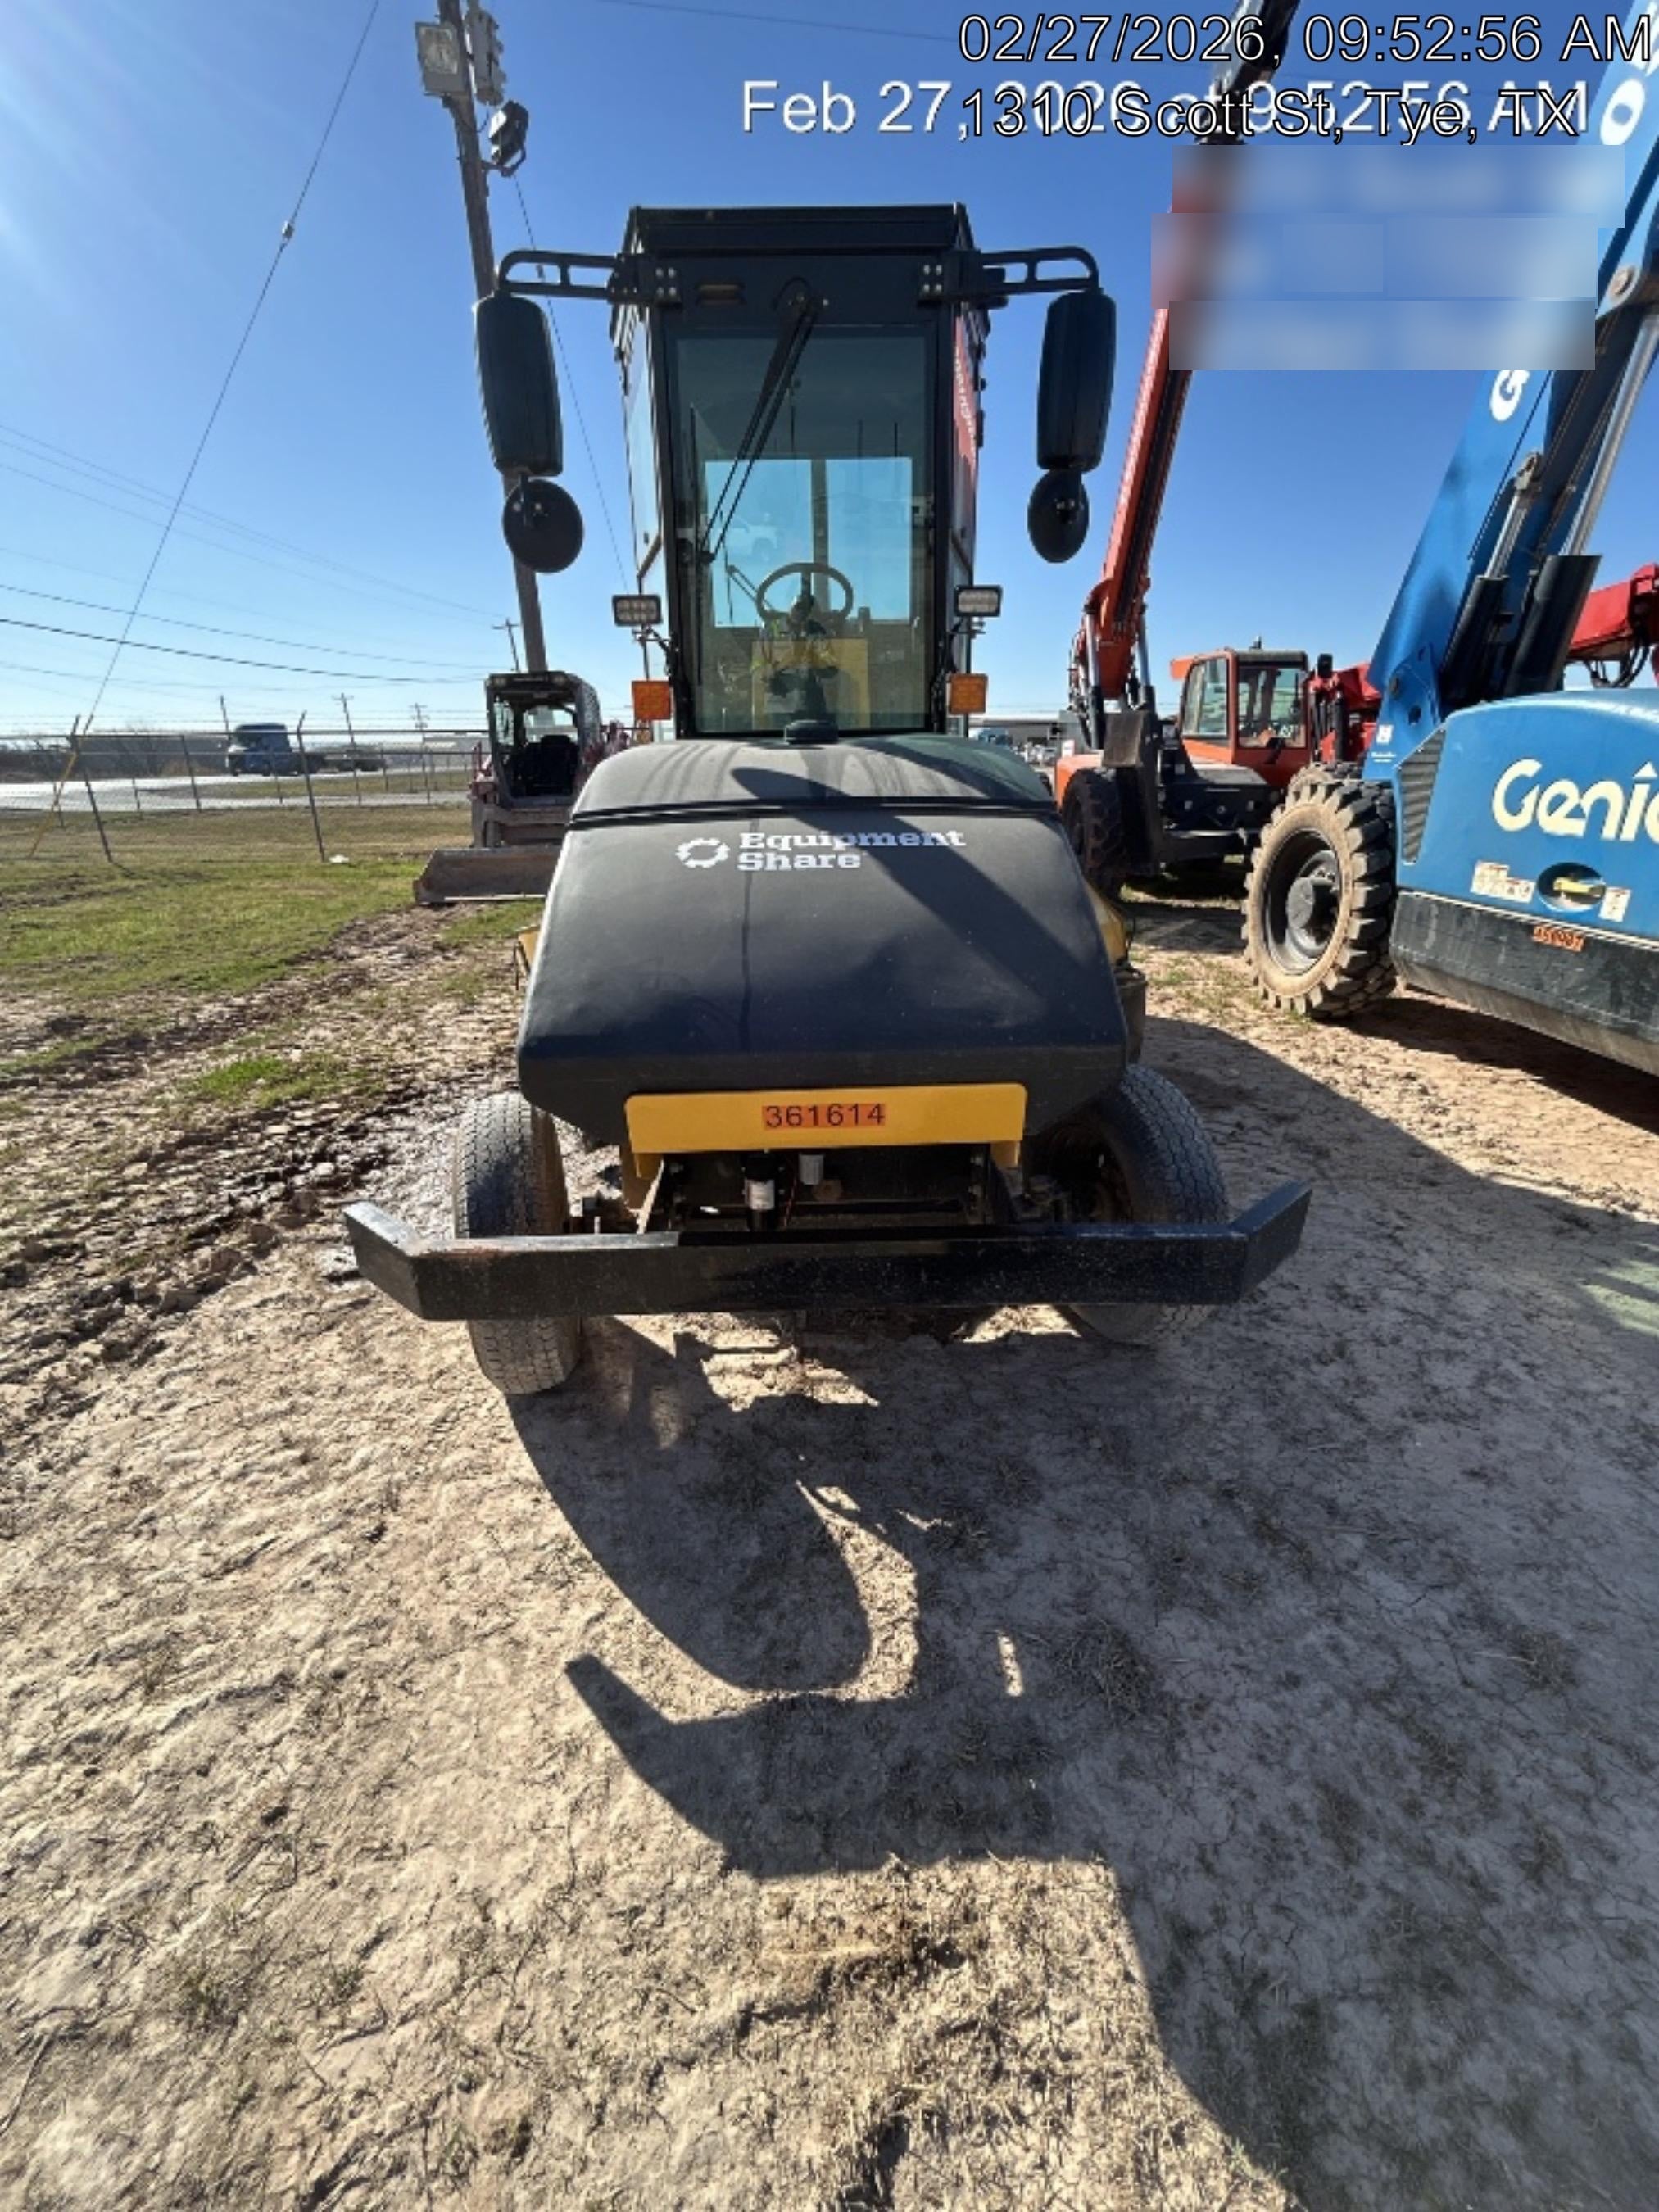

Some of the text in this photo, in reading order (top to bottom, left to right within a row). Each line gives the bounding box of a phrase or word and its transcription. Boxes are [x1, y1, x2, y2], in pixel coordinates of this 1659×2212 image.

[739, 829, 967, 851] Equipment
[737, 850, 862, 872] Share
[765, 1103, 885, 1128] 361614
